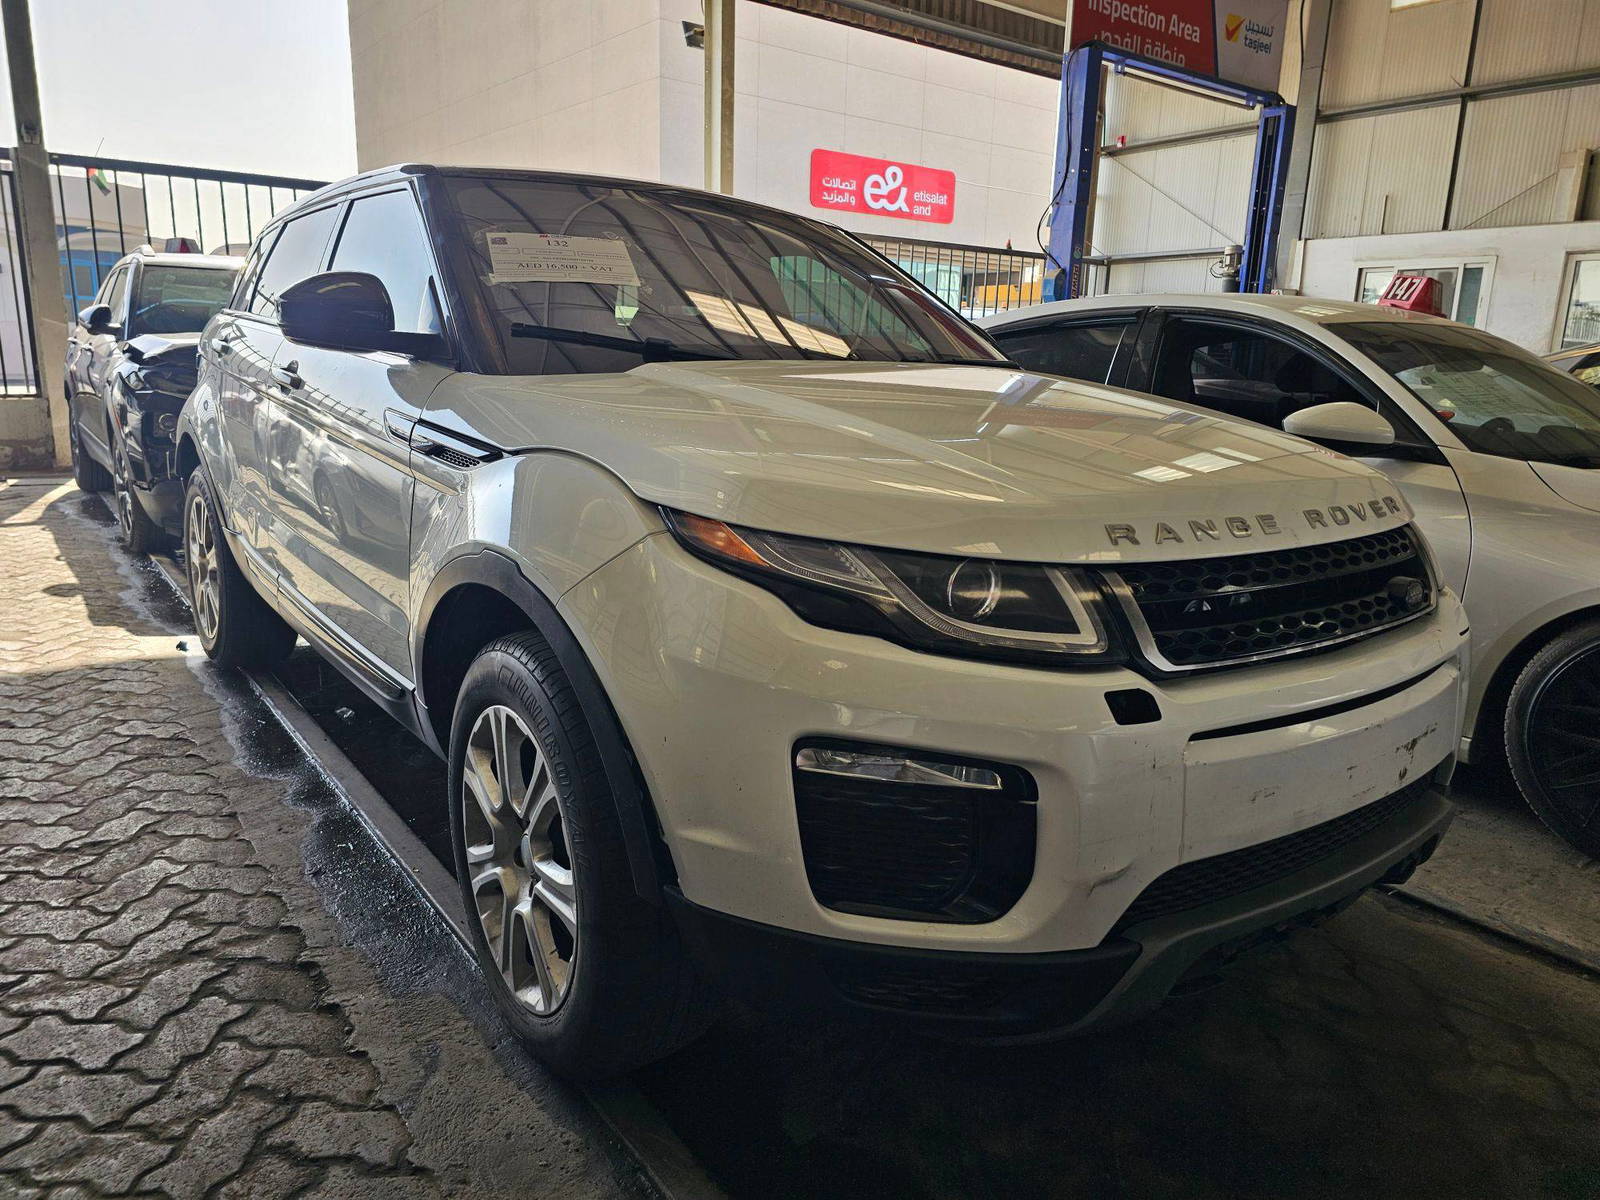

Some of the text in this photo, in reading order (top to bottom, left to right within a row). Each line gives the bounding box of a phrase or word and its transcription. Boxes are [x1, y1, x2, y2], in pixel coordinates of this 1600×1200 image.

[1168, 14, 1201, 43] Area
[1245, 20, 1274, 38] تسجيل
[1243, 35, 1272, 55] tasjeel
[822, 176, 857, 191] اتصالات
[821, 190, 856, 206] والمزيد
[913, 190, 948, 205] etisalat
[913, 204, 932, 216] and
[546, 239, 569, 248] 132
[1387, 277, 1422, 300] 147
[1103, 495, 1401, 546] RANGE ROVER
